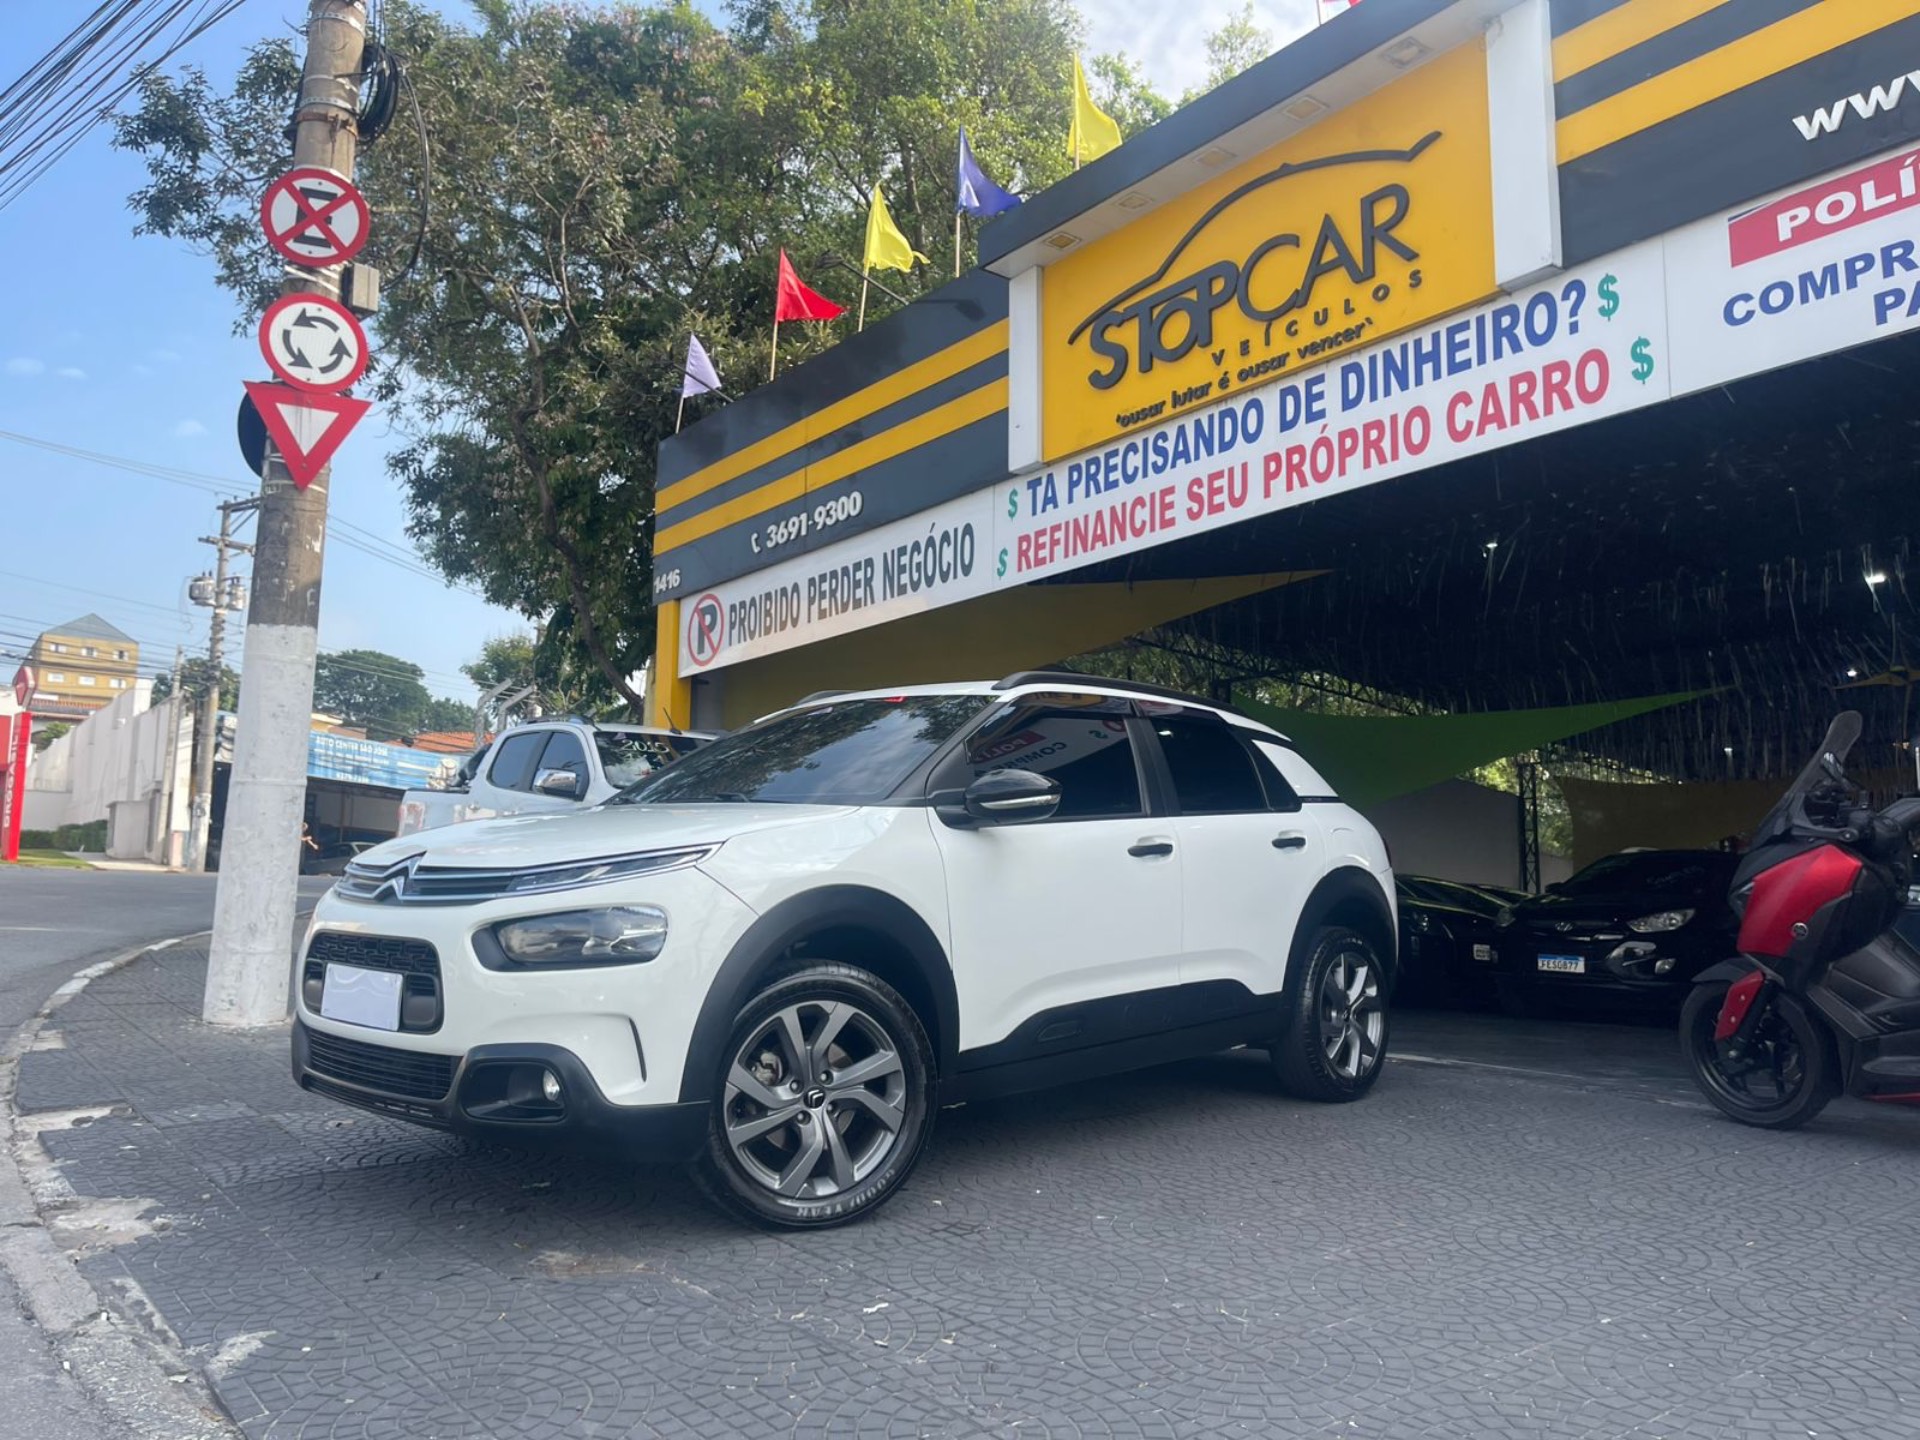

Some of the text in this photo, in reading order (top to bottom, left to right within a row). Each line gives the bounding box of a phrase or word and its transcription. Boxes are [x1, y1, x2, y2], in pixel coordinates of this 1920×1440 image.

[1776, 154, 1920, 242] POLÍ
[1211, 268, 1424, 367] VEÍCULOS
[1027, 472, 1059, 517] TA
[1067, 397, 1264, 504] PRECISANDO
[1279, 373, 1327, 433] DE
[1341, 279, 1586, 412] DINHEIRO?
[1597, 273, 1620, 321] $
[1171, 380, 1212, 409] lutar
[1218, 370, 1230, 390] é
[1237, 351, 1290, 382] ousar
[1017, 485, 1176, 573] REFINANCIE
[1186, 461, 1249, 522] SEU
[1263, 405, 1431, 498] PRÓPRIO
[1446, 348, 1610, 443] CARRO
[1631, 336, 1655, 384] $
[766, 491, 863, 549] 3691-9300
[729, 582, 801, 647] PROIBIDO
[807, 556, 875, 624] PERDER
[883, 522, 975, 601] NEGÓCIO
